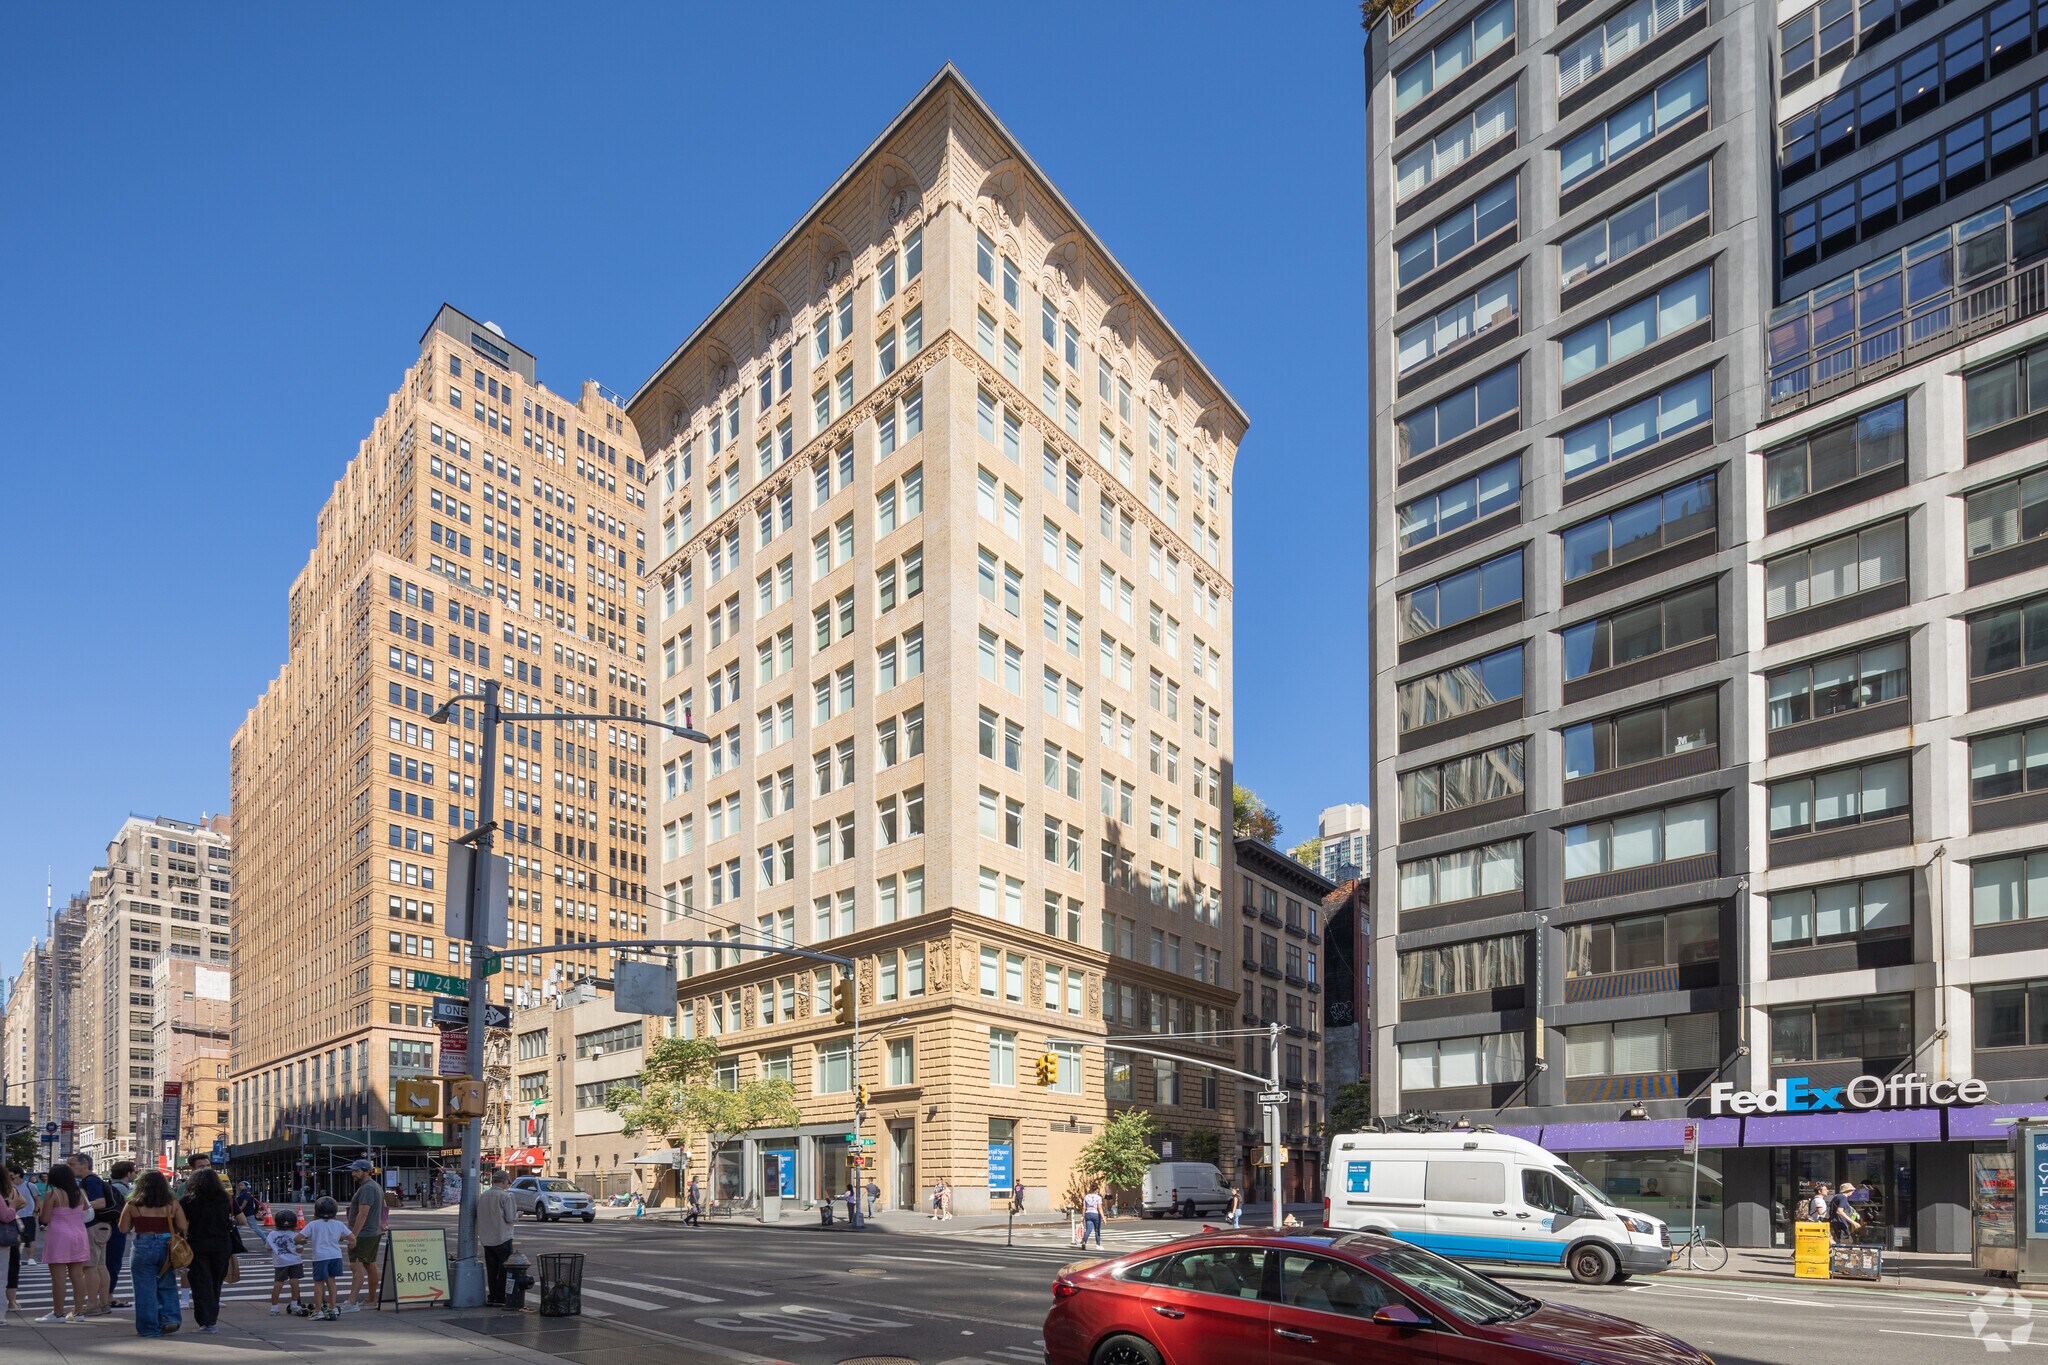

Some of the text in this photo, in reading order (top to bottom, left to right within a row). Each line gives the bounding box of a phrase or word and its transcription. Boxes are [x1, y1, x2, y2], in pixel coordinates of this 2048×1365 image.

[1677, 735, 1688, 745] M
[417, 972, 430, 988] W
[435, 976, 451, 992] 24
[444, 1005, 499, 1021] ONE AY
[1710, 1073, 1988, 1114] FedEx Office
[406, 1255, 428, 1266] 99c
[396, 1270, 442, 1283] & MORE
